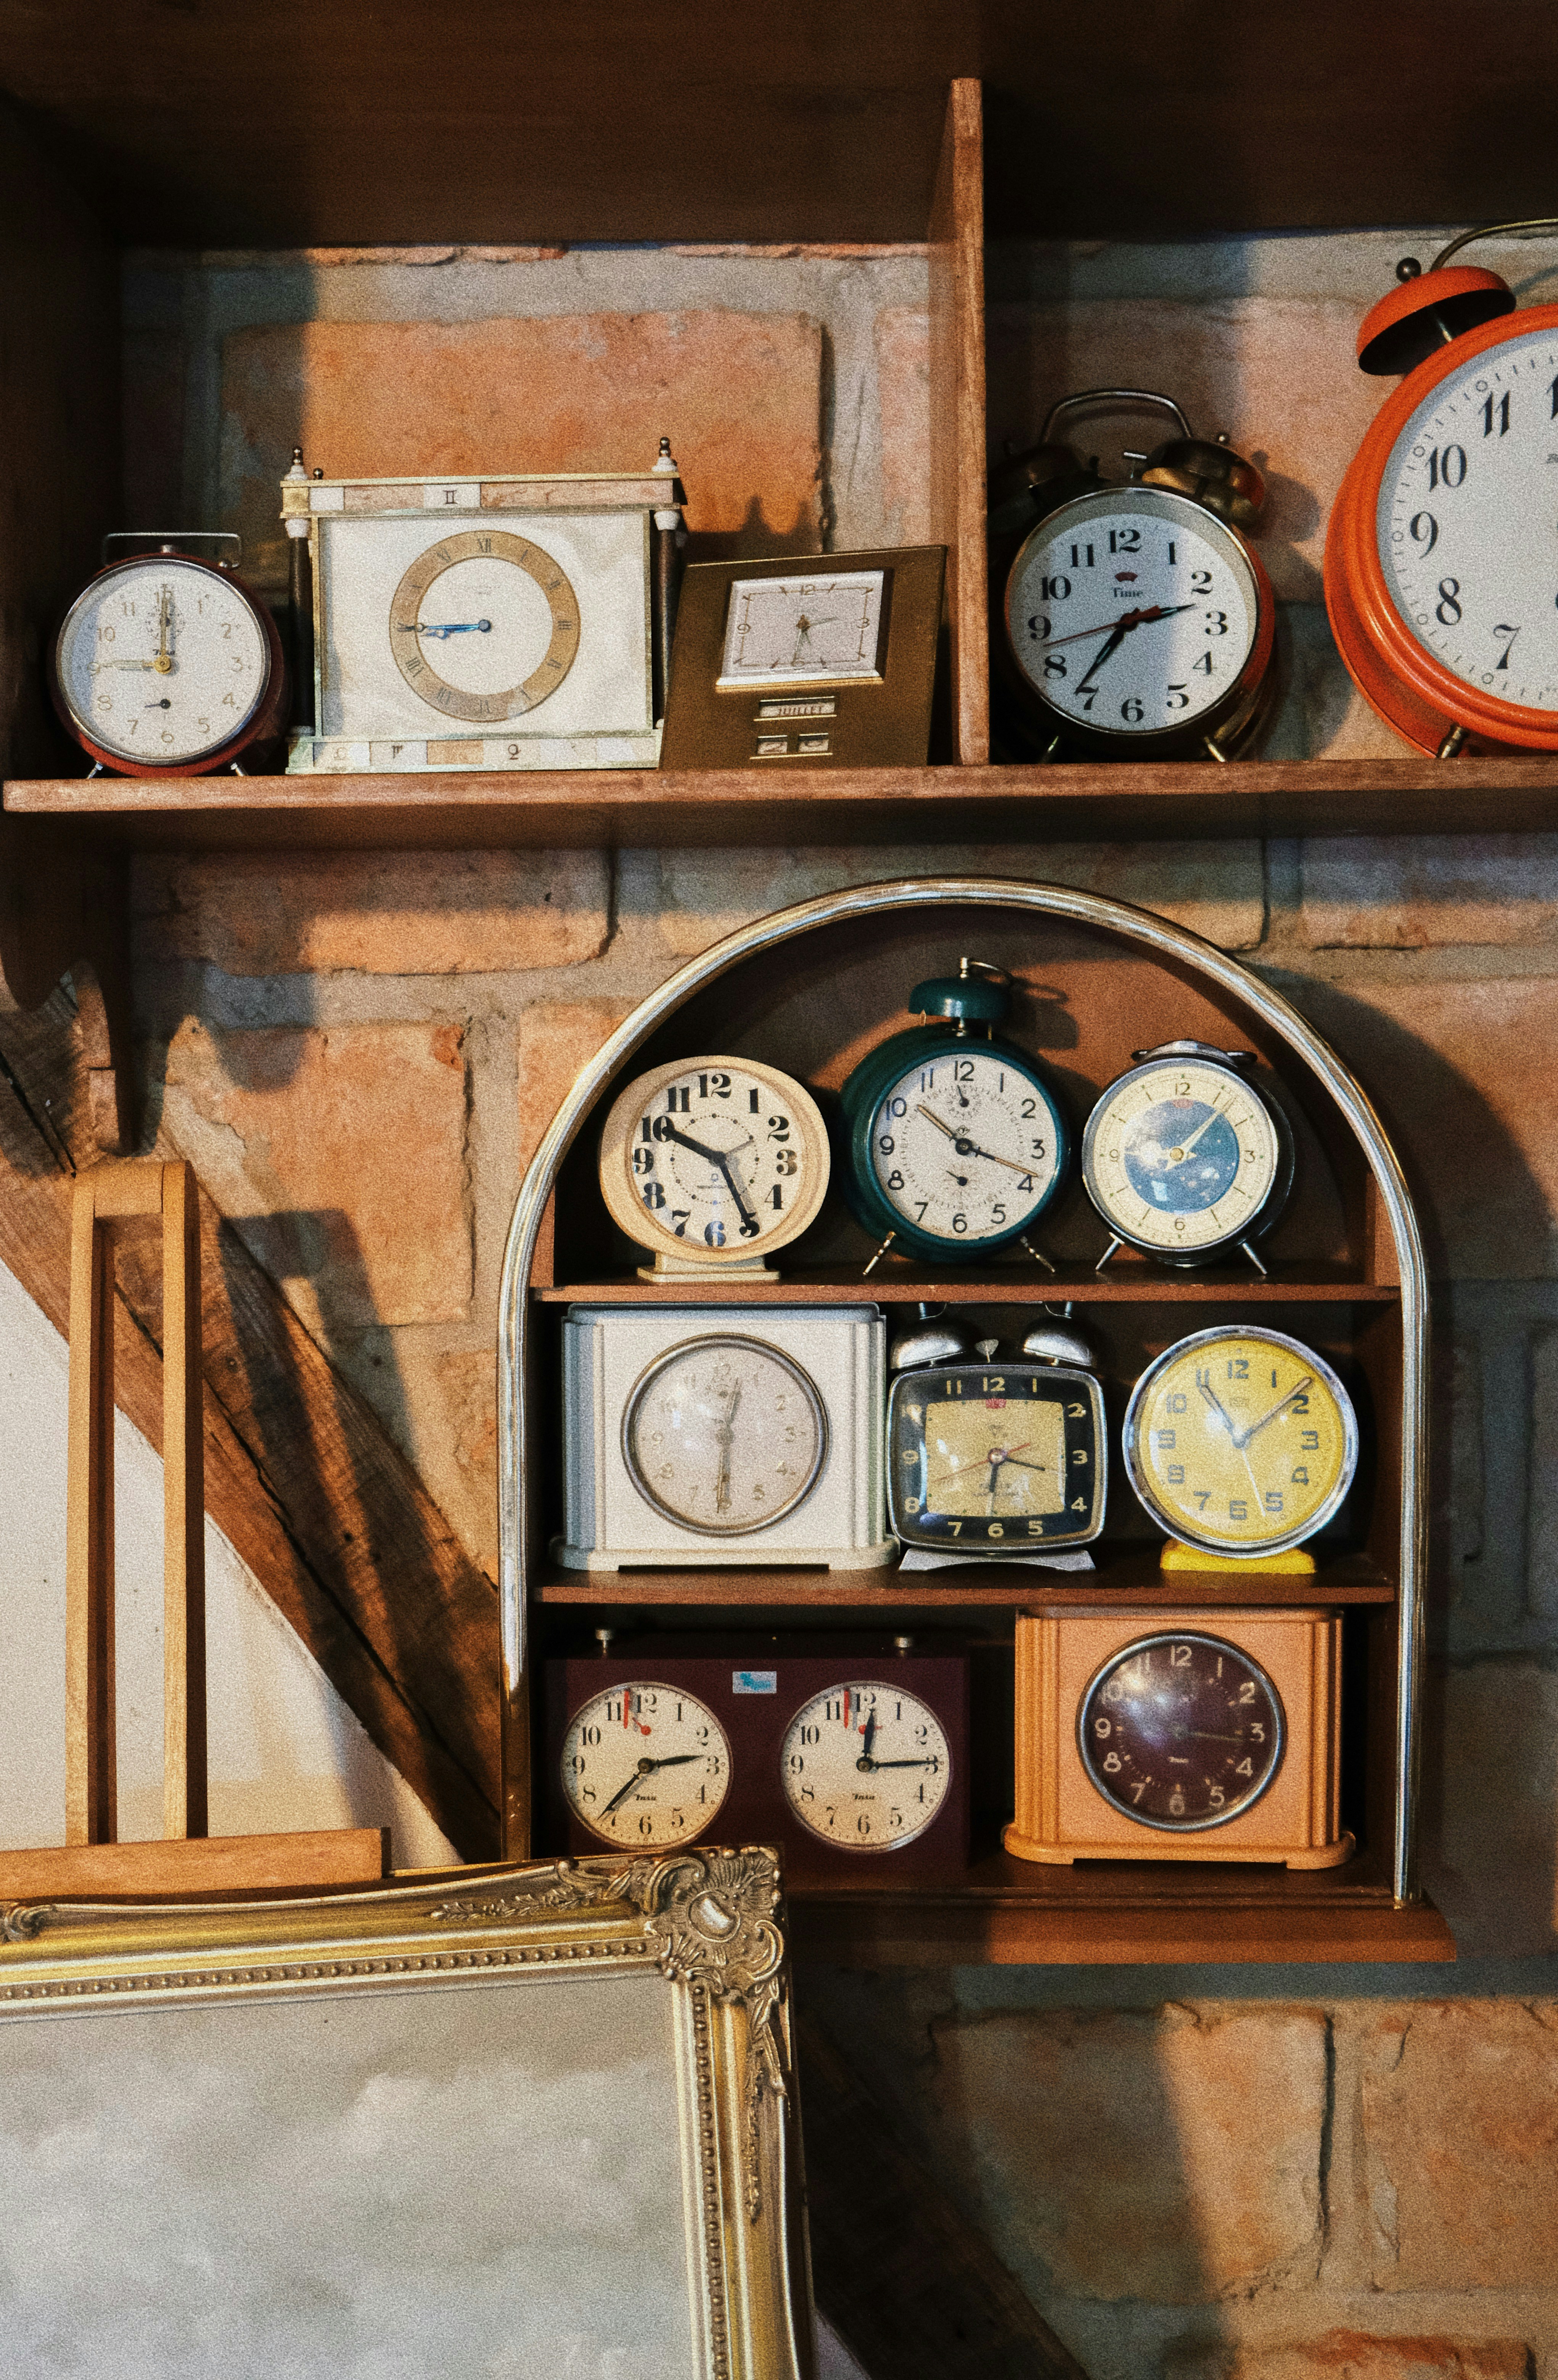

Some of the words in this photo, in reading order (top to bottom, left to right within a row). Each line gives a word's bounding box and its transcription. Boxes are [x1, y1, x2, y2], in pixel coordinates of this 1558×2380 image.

[1547, 373, 1558, 420] 1
[1478, 389, 1511, 437] 11
[1425, 444, 1467, 492] 10
[1109, 529, 1141, 553] 12
[1410, 511, 1439, 559] 9
[477, 538, 491, 553] XII
[1070, 544, 1096, 567] 11
[1168, 542, 1177, 565] 1
[801, 584, 816, 597] 12
[1041, 576, 1072, 600] 10
[1112, 587, 1143, 598] Time
[1191, 571, 1213, 594] 2
[122, 601, 136, 616] 11
[198, 600, 203, 614] 1
[1436, 577, 1462, 626] 8
[221, 624, 232, 639] 2
[558, 621, 572, 630] III
[737, 624, 751, 634] 9
[858, 618, 870, 630] 3
[1028, 615, 1052, 639] 9
[1205, 611, 1228, 635] 3
[98, 627, 115, 642] 10
[1493, 623, 1522, 670] 7
[88, 663, 100, 675] 9
[232, 657, 244, 672] 3
[1044, 655, 1067, 679] 8
[1192, 651, 1217, 675] 4
[97, 695, 112, 710] 8
[222, 693, 235, 707] 4
[1077, 687, 1099, 710] 7
[1166, 683, 1189, 708] 5
[1121, 698, 1144, 722] 6
[127, 720, 139, 735] 7
[198, 718, 210, 733] 5
[161, 731, 174, 743] 6
[921, 1068, 934, 1092] 11
[954, 1060, 974, 1081] 12
[698, 1074, 732, 1098] 12
[1000, 1073, 1004, 1093] 1
[1174, 1082, 1191, 1095] 12
[666, 1086, 691, 1113] 11
[748, 1088, 761, 1114] 1
[886, 1097, 907, 1121] 10
[1021, 1098, 1036, 1119] 2
[641, 1116, 675, 1143] 10
[767, 1116, 790, 1142] 2
[879, 1135, 895, 1155] 9
[1031, 1139, 1045, 1159] 3
[633, 1148, 654, 1174] 9
[776, 1149, 797, 1176] 3
[1109, 1149, 1119, 1162] 9
[1244, 1150, 1256, 1163] 3
[888, 1170, 905, 1190] 8
[1017, 1175, 1034, 1193] 4
[642, 1182, 666, 1209] 8
[764, 1184, 785, 1210] 4
[915, 1201, 929, 1222] 7
[990, 1204, 1006, 1224] 5
[672, 1209, 691, 1237] 7
[739, 1212, 760, 1238] 5
[953, 1213, 968, 1233] 6
[1174, 1218, 1185, 1230] 6
[704, 1221, 726, 1247] 6
[1196, 1368, 1210, 1388] 11
[1228, 1359, 1249, 1379] 12
[1272, 1369, 1277, 1388] 1
[947, 1380, 961, 1394] 11
[983, 1377, 1006, 1391] 12
[1032, 1378, 1037, 1393] 1
[1068, 1403, 1083, 1417] 2
[1166, 1394, 1187, 1413] 10
[1292, 1394, 1309, 1414] 2
[785, 1426, 796, 1443] 3
[1158, 1429, 1176, 1449] 9
[1301, 1431, 1318, 1450] 3
[902, 1451, 918, 1465] 9
[1072, 1451, 1088, 1464] 3
[1167, 1465, 1185, 1484] 8
[1291, 1467, 1310, 1486] 4
[753, 1484, 764, 1500] 5
[1194, 1491, 1211, 1511] 7
[1266, 1492, 1283, 1512] 5
[904, 1498, 920, 1513] 8
[1071, 1498, 1087, 1512] 4
[1229, 1500, 1248, 1520] 6
[948, 1522, 962, 1536] 7
[988, 1523, 1004, 1537] 6
[1028, 1521, 1043, 1535] 5
[1170, 1645, 1192, 1667] 12
[1217, 1657, 1222, 1677] 1
[636, 1693, 657, 1713] 12
[854, 1692, 876, 1712] 12
[1239, 1682, 1255, 1704] 2
[605, 1702, 621, 1721] 11
[674, 1703, 684, 1721] 1
[824, 1700, 841, 1720] 11
[894, 1701, 901, 1721] 1
[580, 1726, 601, 1746] 10
[696, 1726, 708, 1746] 2
[799, 1725, 820, 1745] 10
[915, 1725, 928, 1745] 2
[1094, 1718, 1111, 1738] 9
[1250, 1723, 1265, 1742] 3
[572, 1756, 585, 1775] 9
[706, 1756, 719, 1775] 3
[791, 1754, 804, 1775] 9
[925, 1754, 938, 1775] 3
[1103, 1752, 1121, 1772] 8
[1236, 1757, 1253, 1777] 4
[583, 1784, 596, 1804] 8
[695, 1784, 707, 1804] 4
[801, 1784, 815, 1803] 8
[915, 1783, 926, 1803] 4
[1130, 1783, 1145, 1803] 7
[1209, 1786, 1225, 1807] 5
[639, 1816, 652, 1835] 6
[671, 1808, 684, 1827] 5
[826, 1806, 838, 1826] 7
[857, 1814, 870, 1834] 6
[890, 1807, 902, 1827] 5
